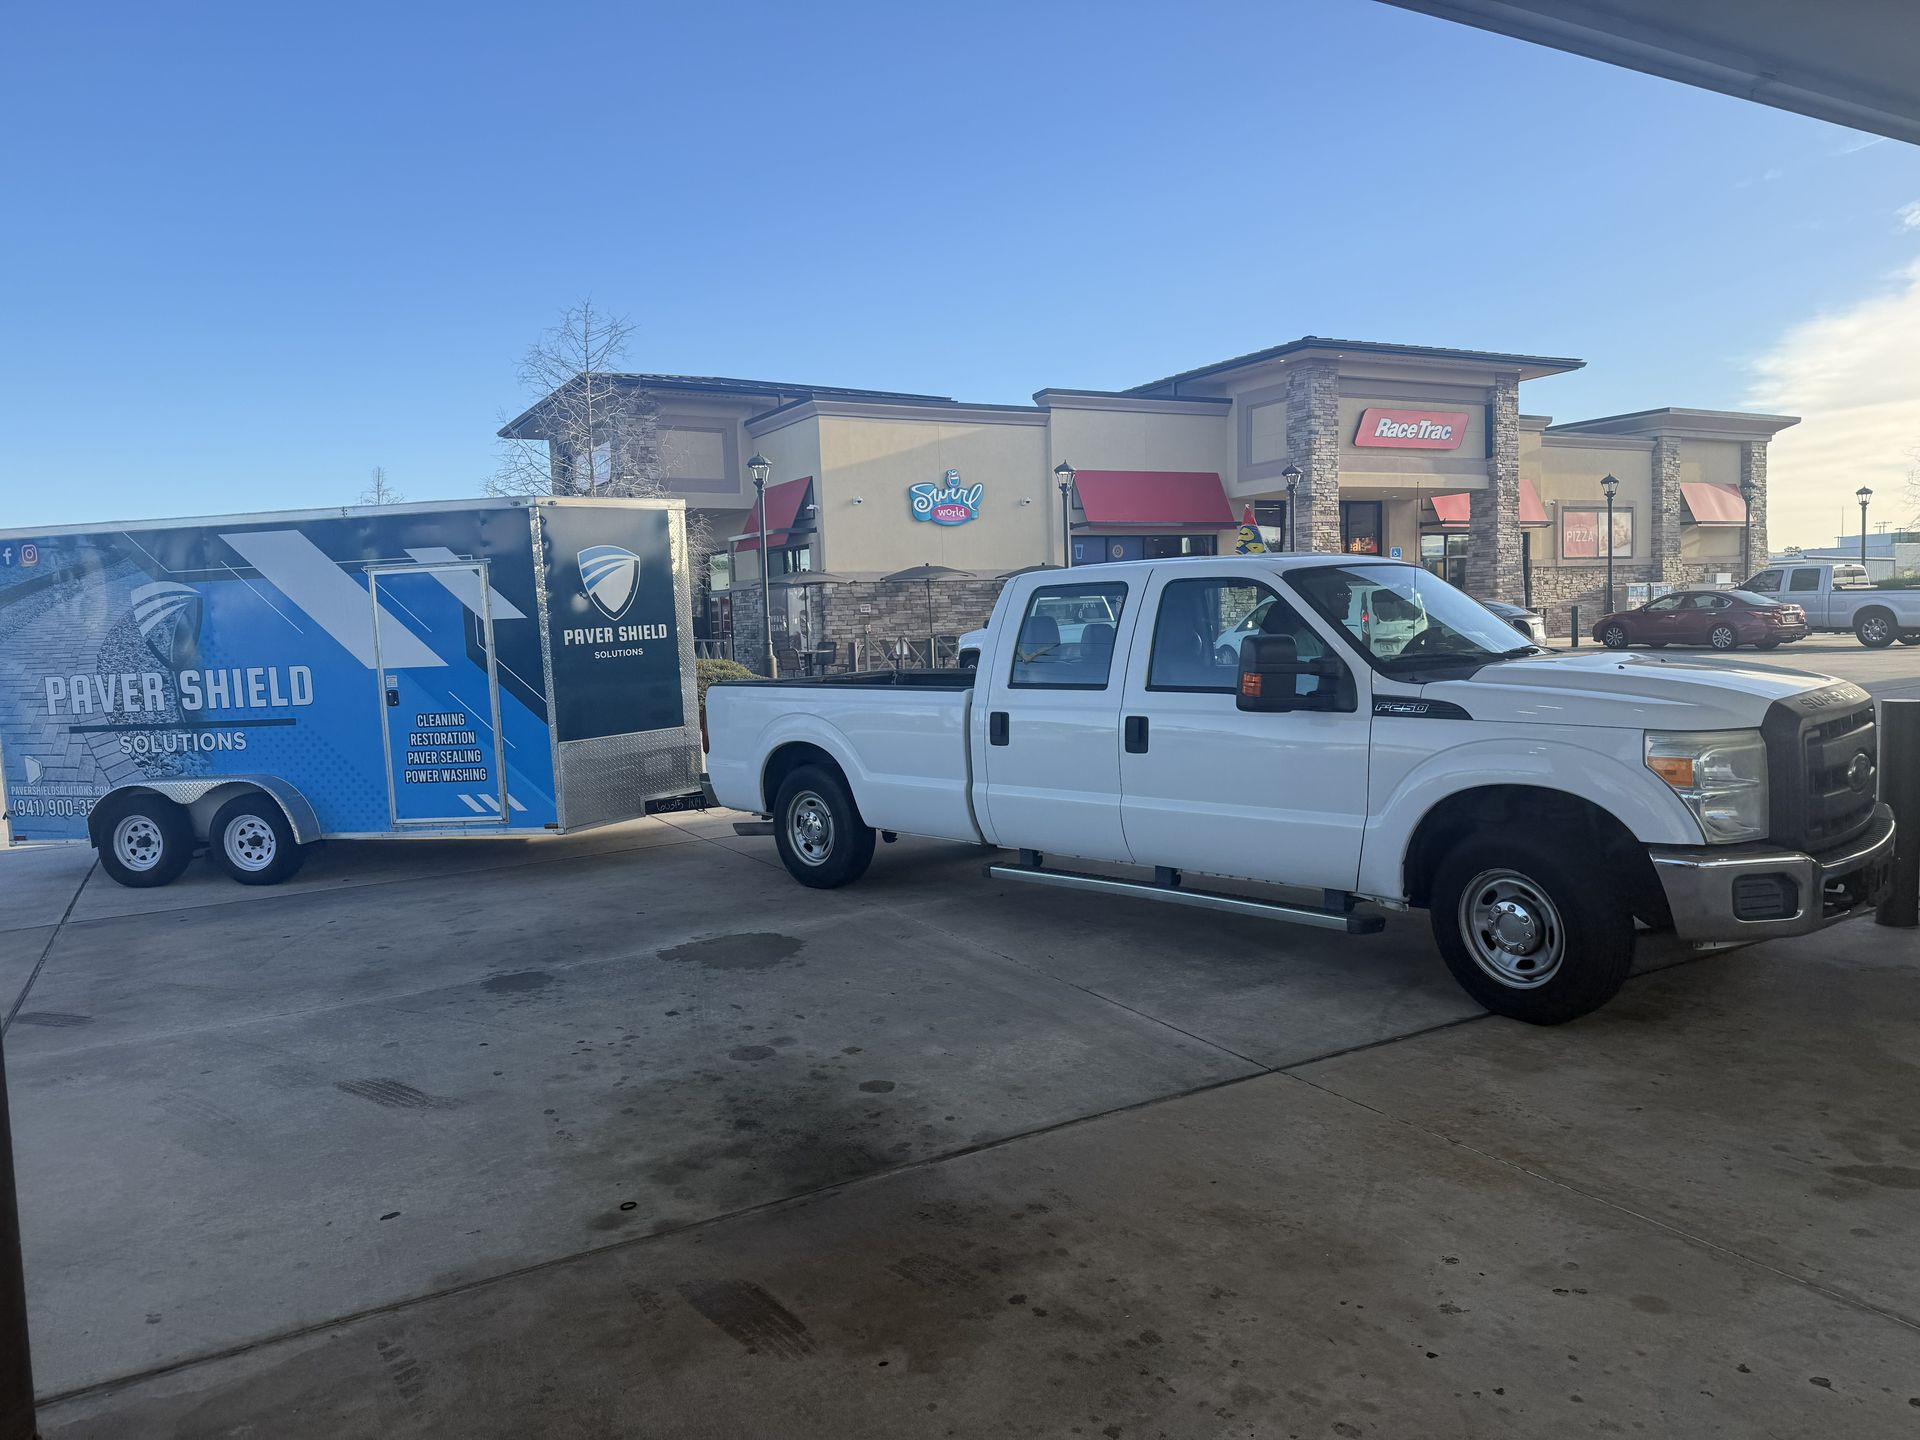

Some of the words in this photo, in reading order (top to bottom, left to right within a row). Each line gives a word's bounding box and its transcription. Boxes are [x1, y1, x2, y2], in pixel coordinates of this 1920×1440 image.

[1375, 418, 1452, 440] RaceTrac
[911, 483, 983, 512] Swirl
[937, 507, 965, 517] world
[1566, 531, 1594, 542] PIZZA
[563, 627, 614, 646] PAVER
[618, 624, 668, 642] SHIELD
[594, 647, 644, 659] SOLUTIONS
[44, 673, 165, 715] PAVER
[179, 665, 314, 711] SHIELD
[416, 713, 465, 727] CLEANING
[119, 731, 247, 755] SOLUTIONS
[410, 731, 475, 746] RESTORATION
[407, 751, 438, 764] PAVER
[440, 749, 481, 763] SEALING
[405, 770, 439, 783] POWER
[441, 768, 487, 782] WASHING
[13, 799, 45, 816] (941)
[48, 799, 99, 816] 900-35
